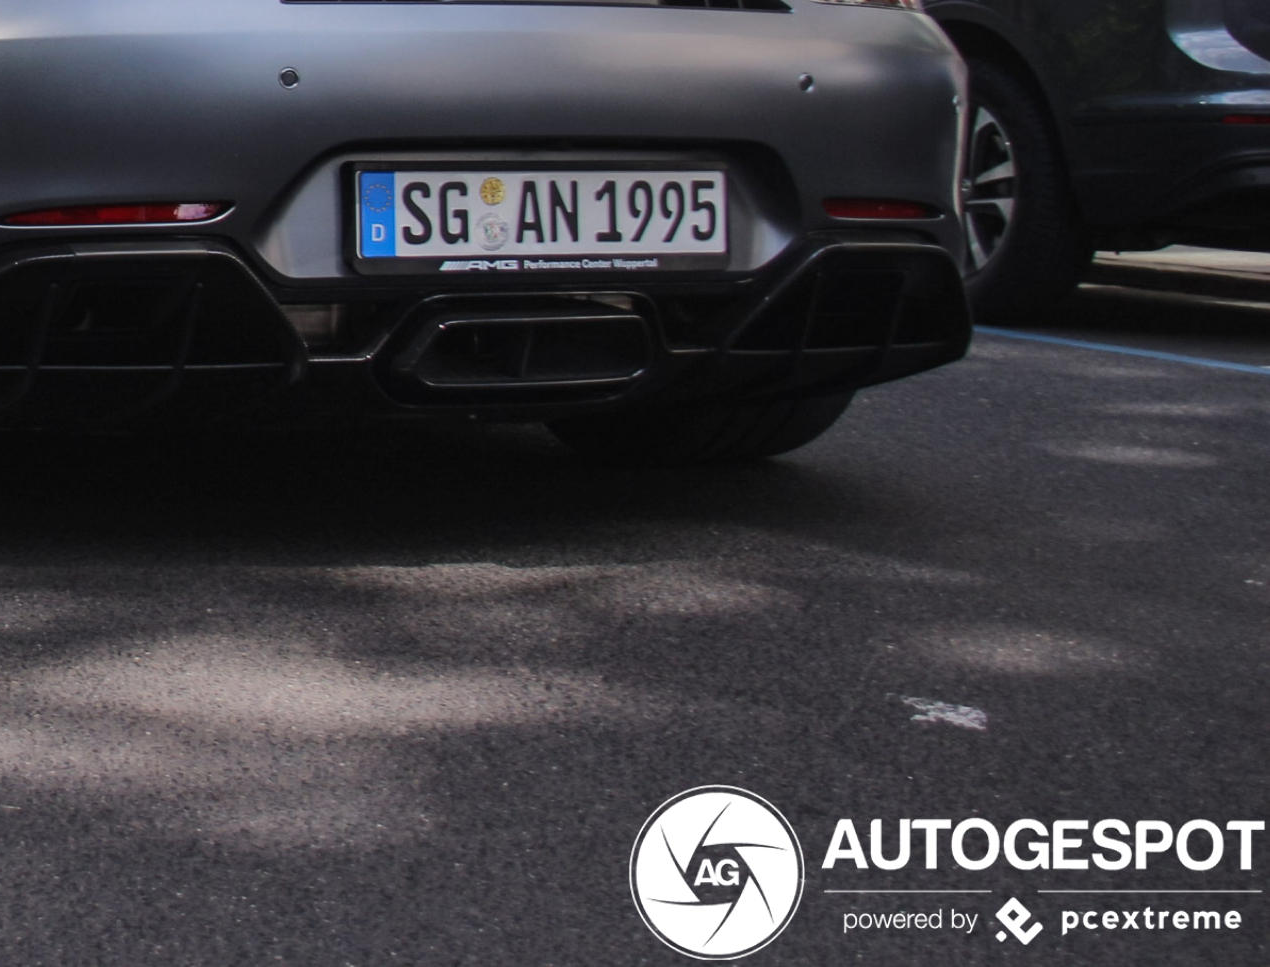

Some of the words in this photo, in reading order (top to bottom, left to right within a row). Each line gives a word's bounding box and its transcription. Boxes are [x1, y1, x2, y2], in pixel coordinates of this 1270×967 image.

[402, 181, 469, 245] SG
[371, 223, 386, 242] D
[523, 259, 580, 270] Performance
[581, 258, 612, 269] Center
[612, 258, 658, 270] Wuppertal
